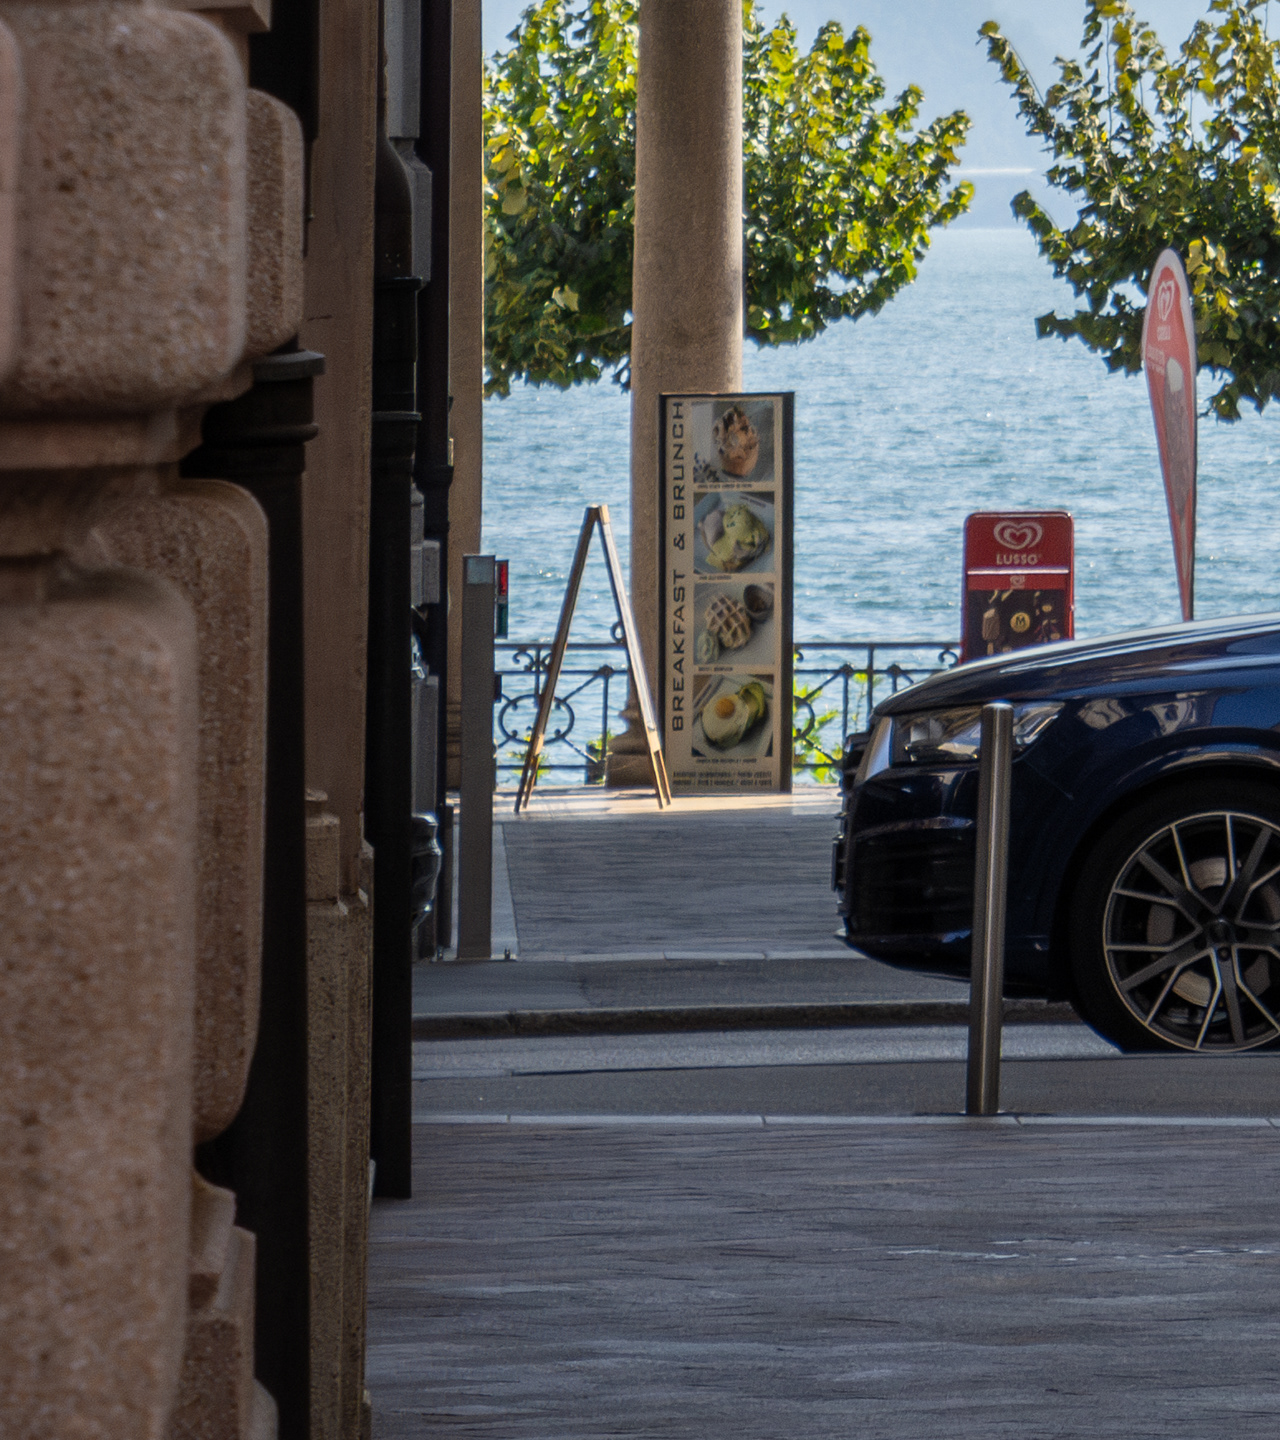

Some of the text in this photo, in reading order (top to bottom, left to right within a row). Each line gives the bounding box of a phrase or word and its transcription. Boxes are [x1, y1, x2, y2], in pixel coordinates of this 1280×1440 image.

[672, 402, 686, 732] BREAKFAST & BRUNCH
